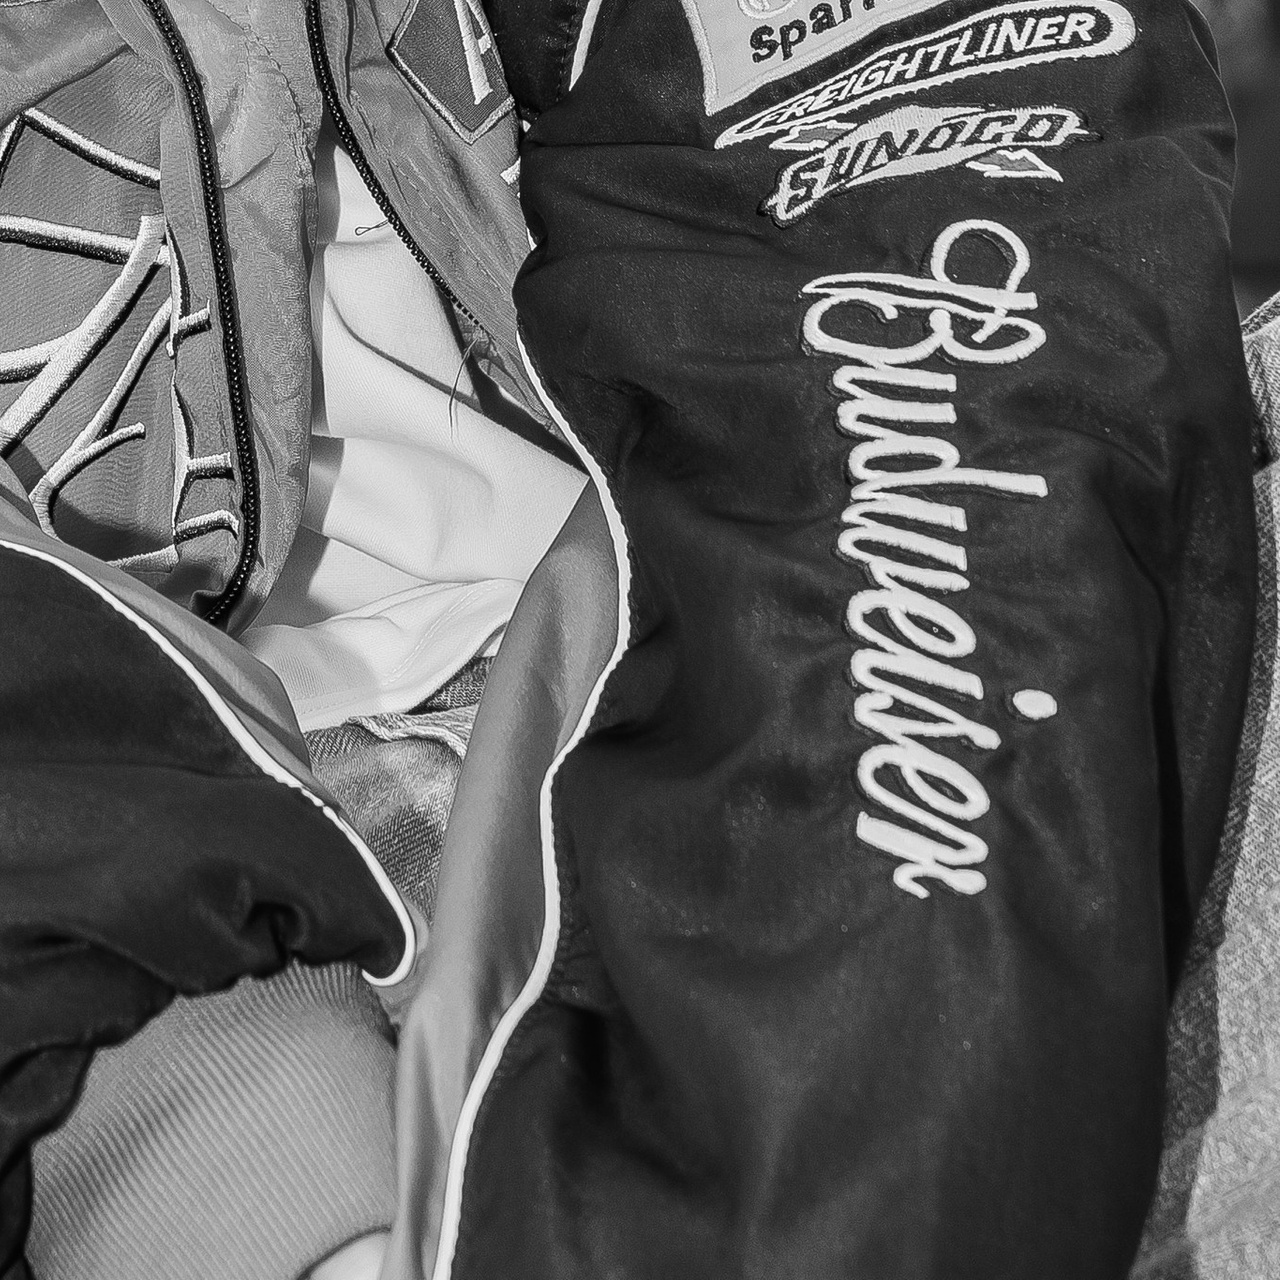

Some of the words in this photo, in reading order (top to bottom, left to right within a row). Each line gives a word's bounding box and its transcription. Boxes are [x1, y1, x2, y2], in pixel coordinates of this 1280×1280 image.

[754, 12, 1097, 130] FREIGHTLINER
[772, 107, 1085, 216] SUNOCO
[802, 218, 1058, 899] Budweiser
